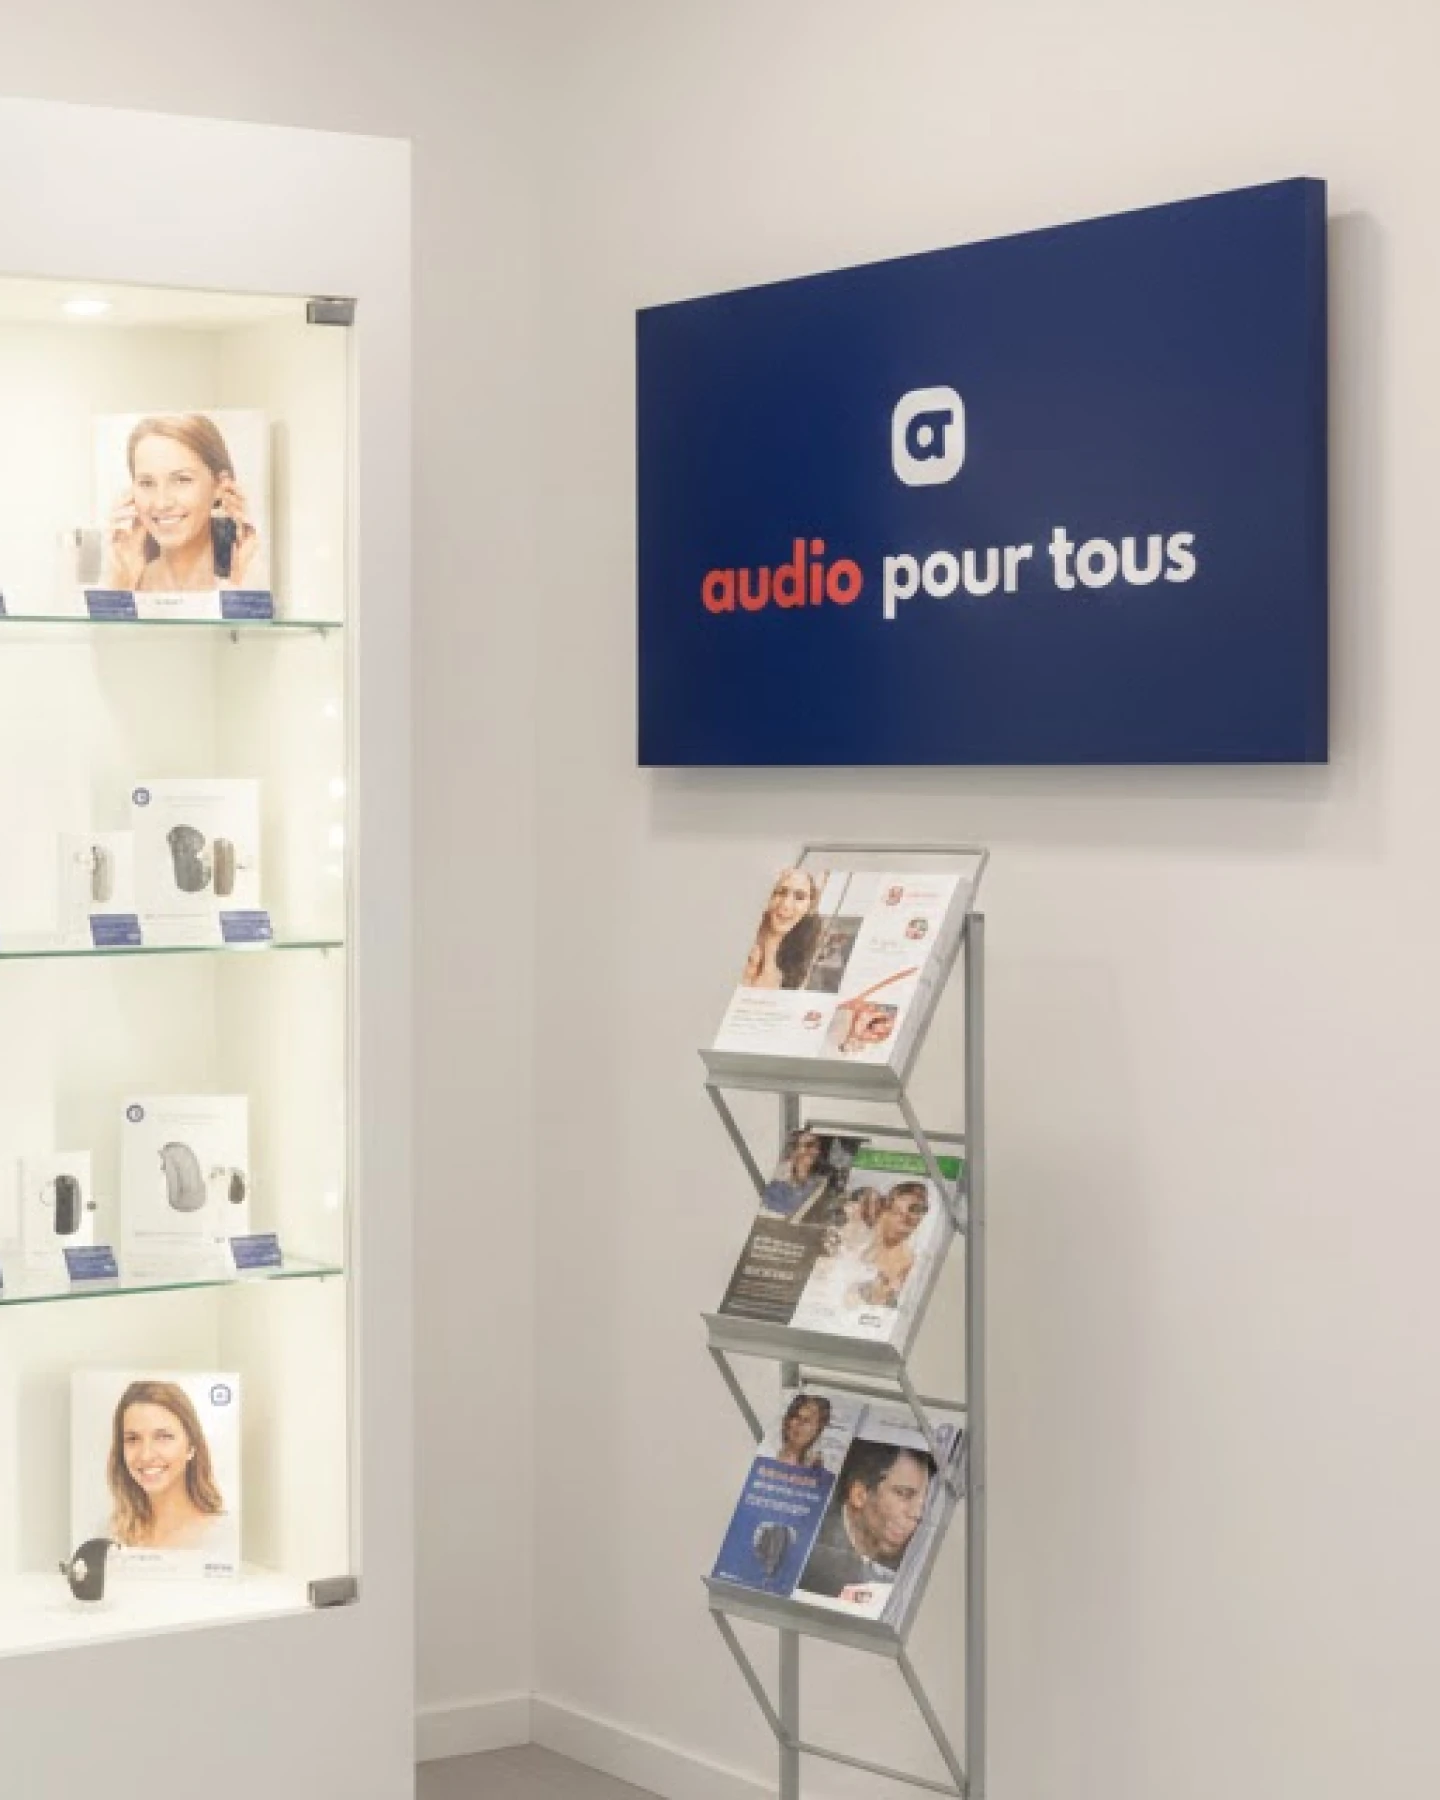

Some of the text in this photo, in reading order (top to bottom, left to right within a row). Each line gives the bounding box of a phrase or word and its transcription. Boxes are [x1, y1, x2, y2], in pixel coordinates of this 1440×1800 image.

[702, 526, 1196, 620] audio pour tous
